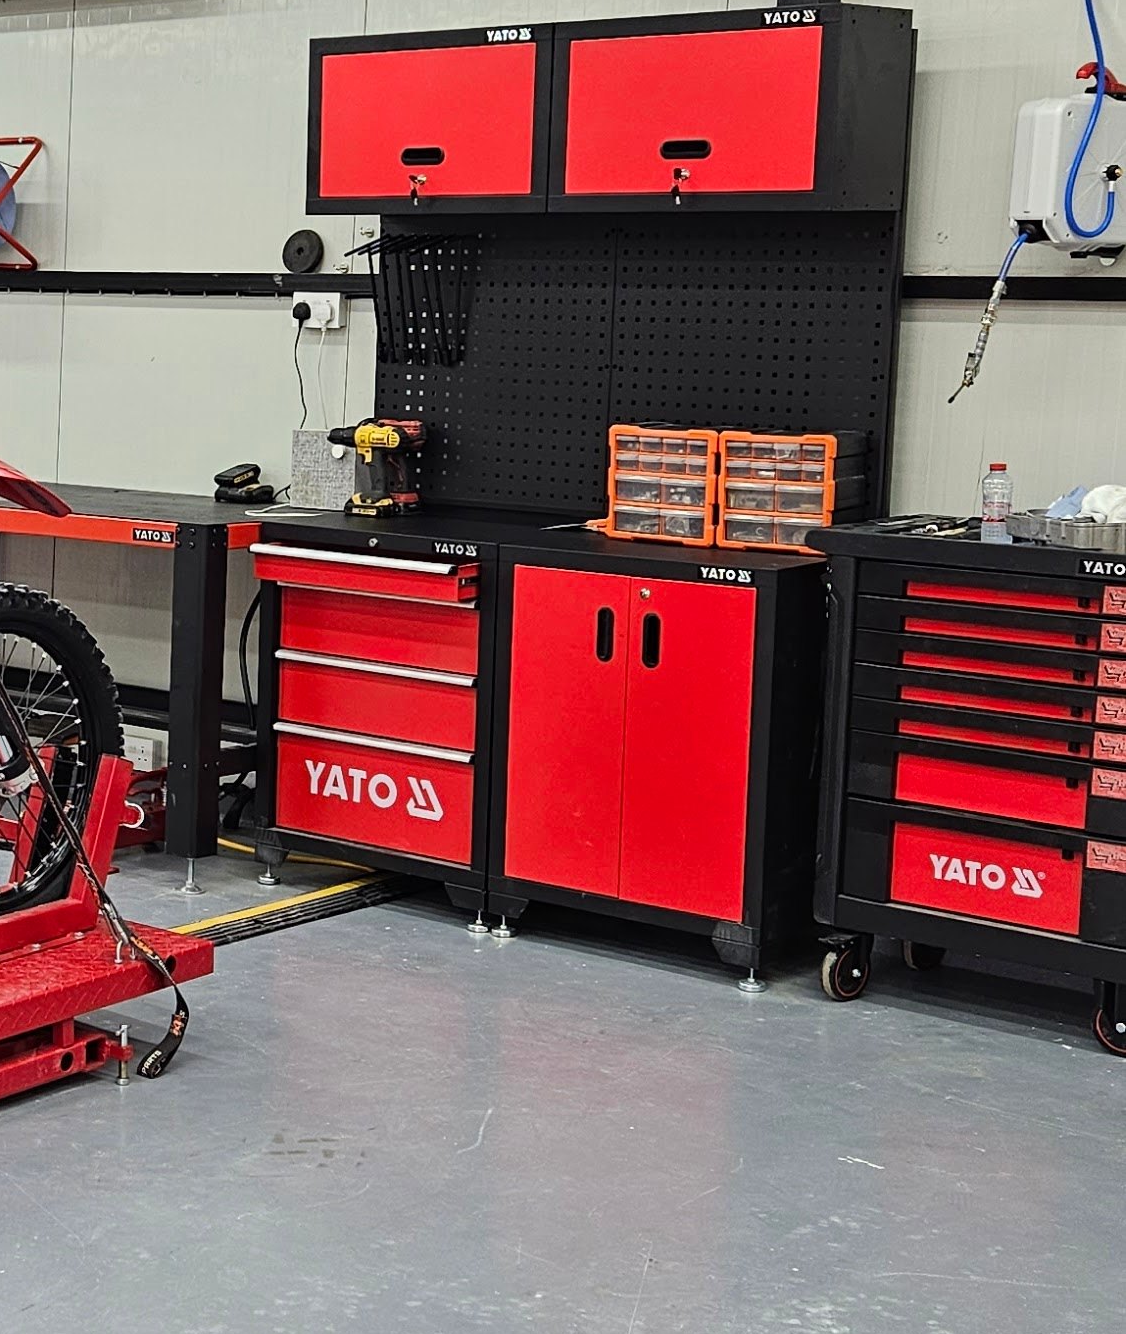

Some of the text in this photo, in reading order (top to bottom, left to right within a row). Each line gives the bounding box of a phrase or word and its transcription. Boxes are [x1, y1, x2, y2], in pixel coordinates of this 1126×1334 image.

[763, 11, 799, 25] YATO
[486, 29, 518, 42] YATO
[134, 529, 161, 541] YATO
[434, 542, 463, 555] YATO
[700, 567, 736, 582] YATO
[1083, 560, 1126, 576] YATO
[305, 759, 398, 809] YATO
[929, 853, 1006, 891] YATO
